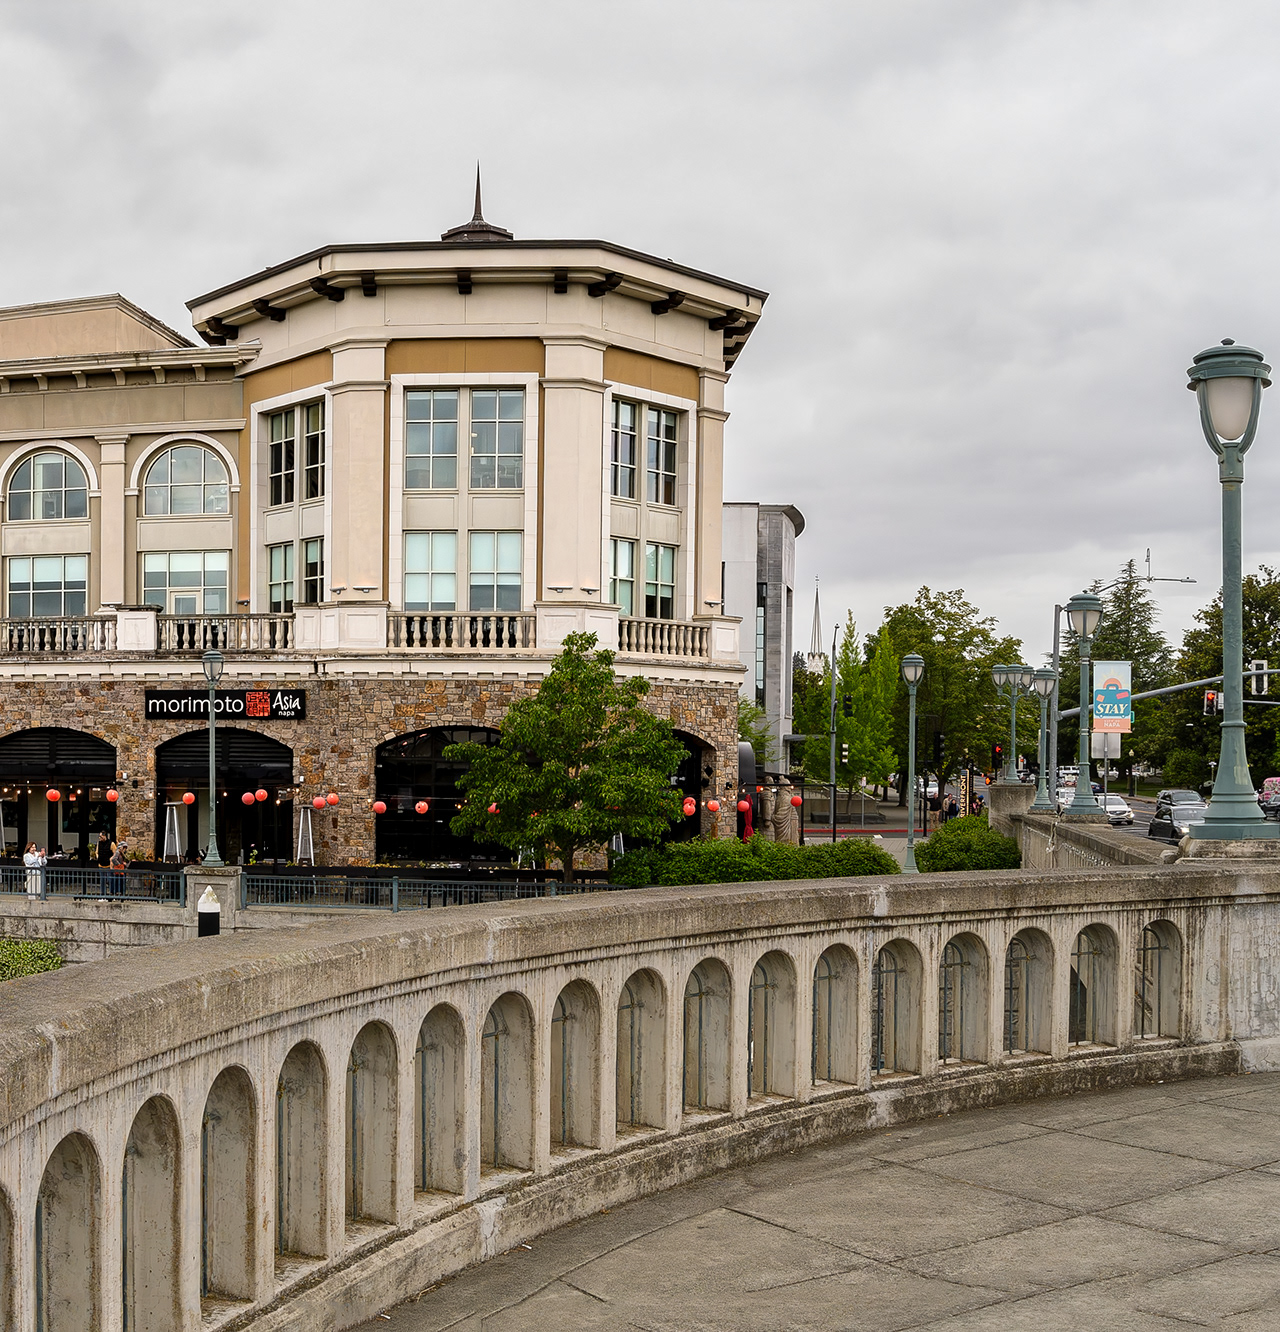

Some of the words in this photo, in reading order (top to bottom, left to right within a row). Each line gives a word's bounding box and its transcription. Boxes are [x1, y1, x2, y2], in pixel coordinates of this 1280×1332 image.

[148, 696, 244, 713] morimoto
[272, 691, 301, 711] Asia
[1095, 703, 1129, 714] STAY
